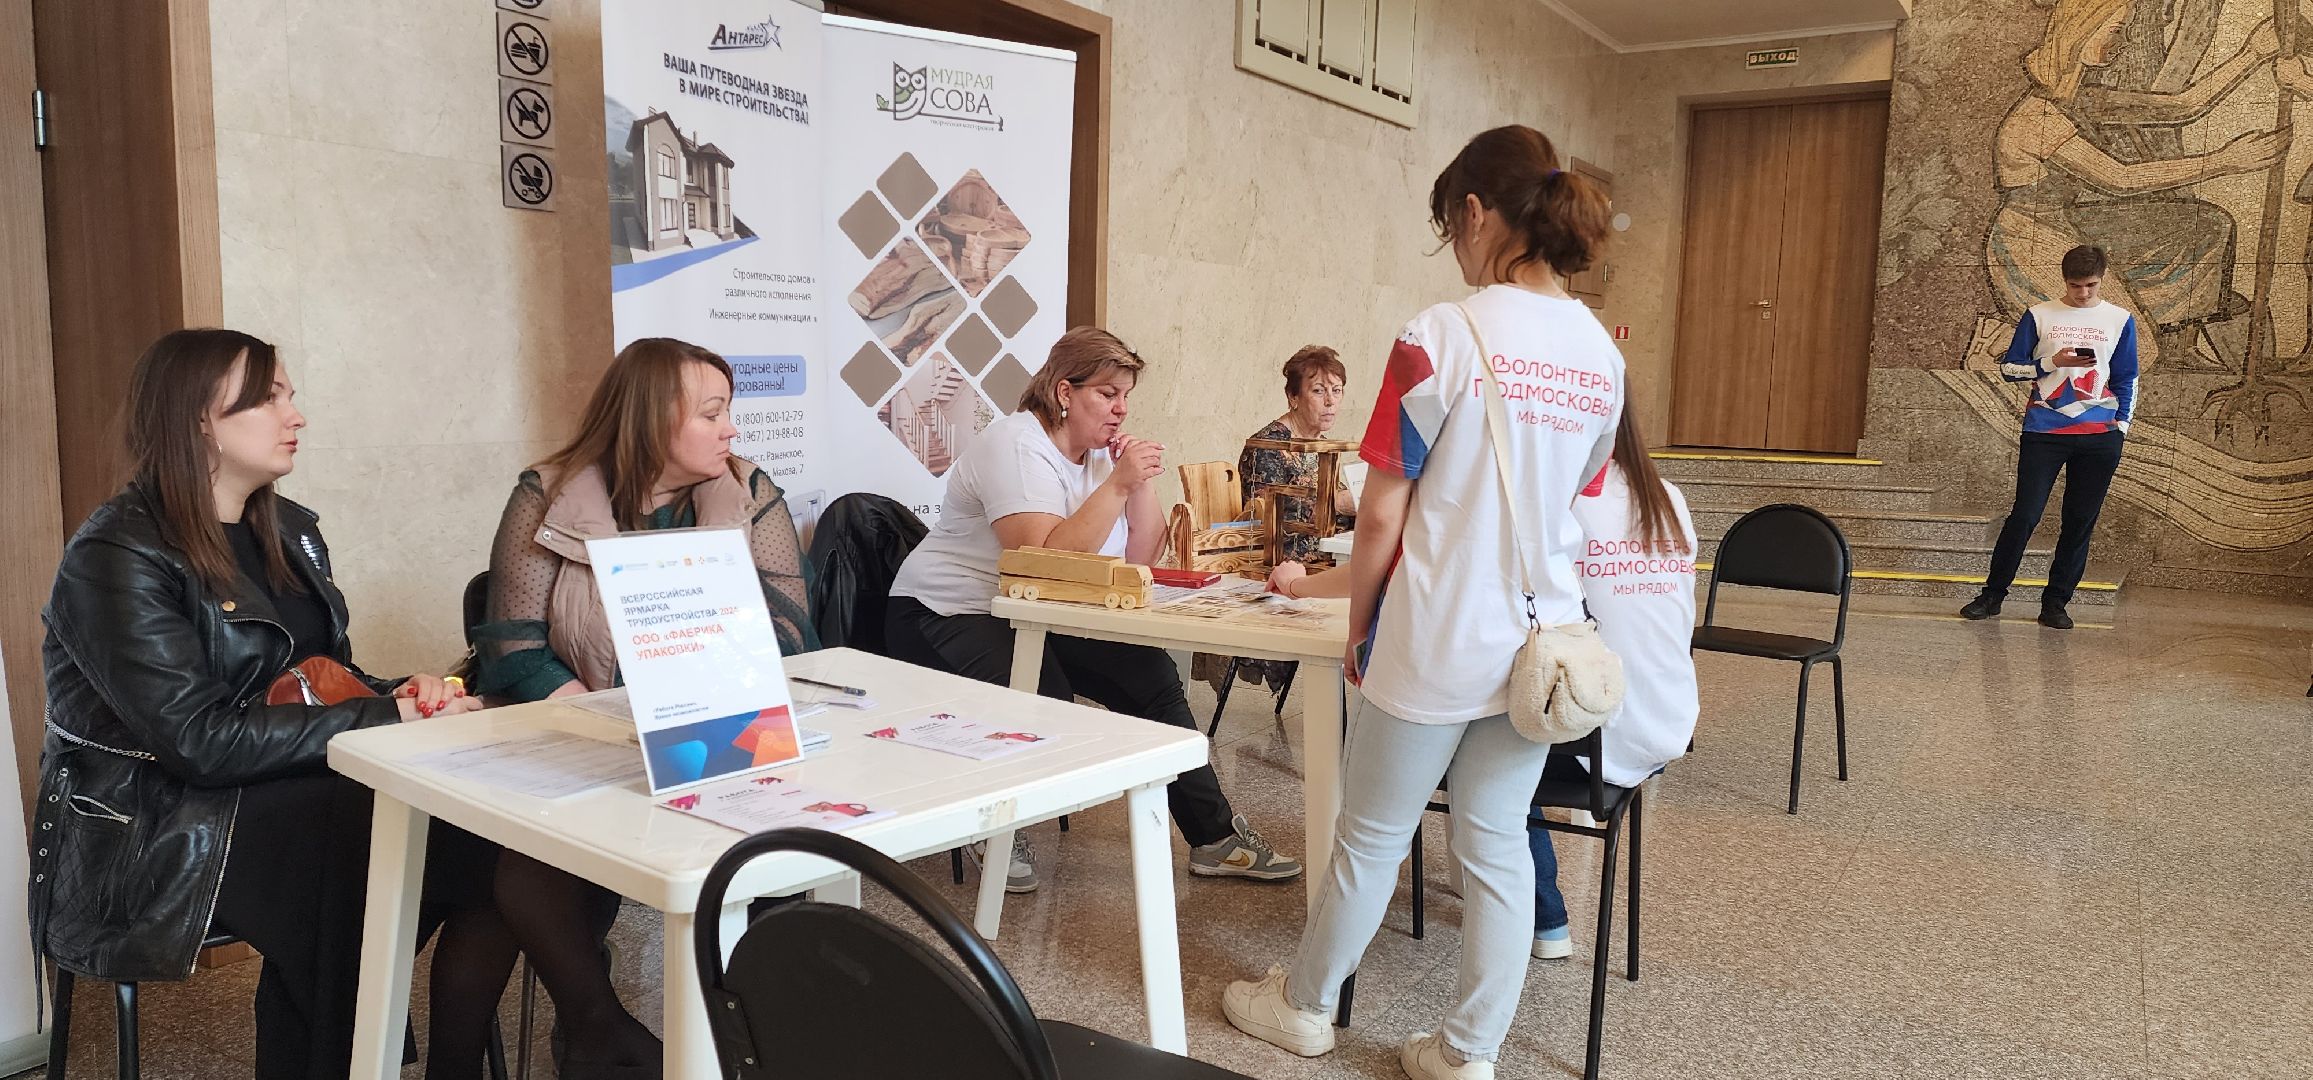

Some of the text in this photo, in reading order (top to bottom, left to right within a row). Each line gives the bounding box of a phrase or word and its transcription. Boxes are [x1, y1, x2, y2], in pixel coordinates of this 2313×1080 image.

[1749, 52, 1796, 64] ВЫХОД
[664, 53, 808, 108] ВАША ПУТЕВОДНАЯ ЗВЕЗДА
[931, 67, 993, 91] МУДРАЯ
[679, 78, 809, 125] В МИРЕ СТРОИТЕЛЬСТВА!
[931, 87, 993, 116] СОВА
[733, 268, 811, 284] Строительство домов
[725, 287, 812, 301] различного исполнения
[709, 308, 811, 324] Инженерные коммуникации
[774, 362, 798, 375] цены
[736, 410, 804, 427] 8 (800) 600-12-79
[1540, 414, 1585, 434] РЯДОМ
[743, 429, 763, 444] (967)
[760, 454, 765, 462] г.
[800, 463, 804, 474] 7
[620, 586, 704, 605] ВСЕРОССИЙСКАЯ
[1614, 582, 1679, 596] МЫ РЯДОМ
[623, 602, 670, 617] ЯРМАРКА
[626, 608, 718, 628] ТРУДОУСТРОЙСТВА
[632, 623, 725, 646] ООО «ФАБРИКА
[636, 641, 705, 661] УПАКОВКИ»
